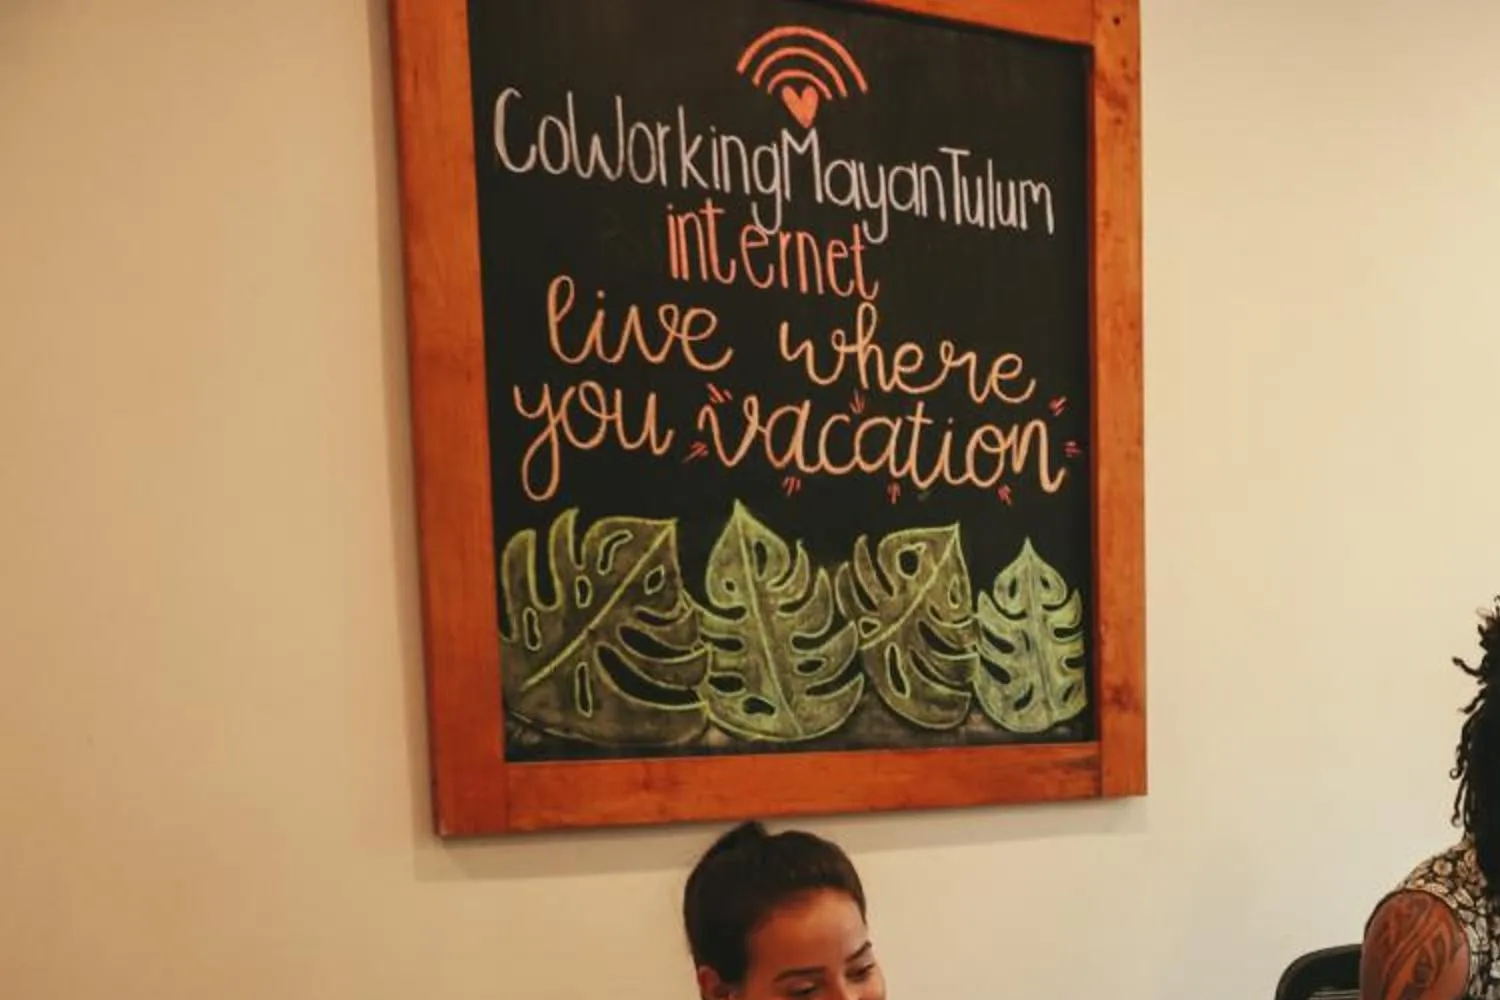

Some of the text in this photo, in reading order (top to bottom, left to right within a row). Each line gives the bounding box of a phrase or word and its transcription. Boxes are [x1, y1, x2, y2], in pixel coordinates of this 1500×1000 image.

[667, 199, 878, 300] internet
[547, 275, 1036, 404] live where
[513, 380, 1066, 501] you vacation
